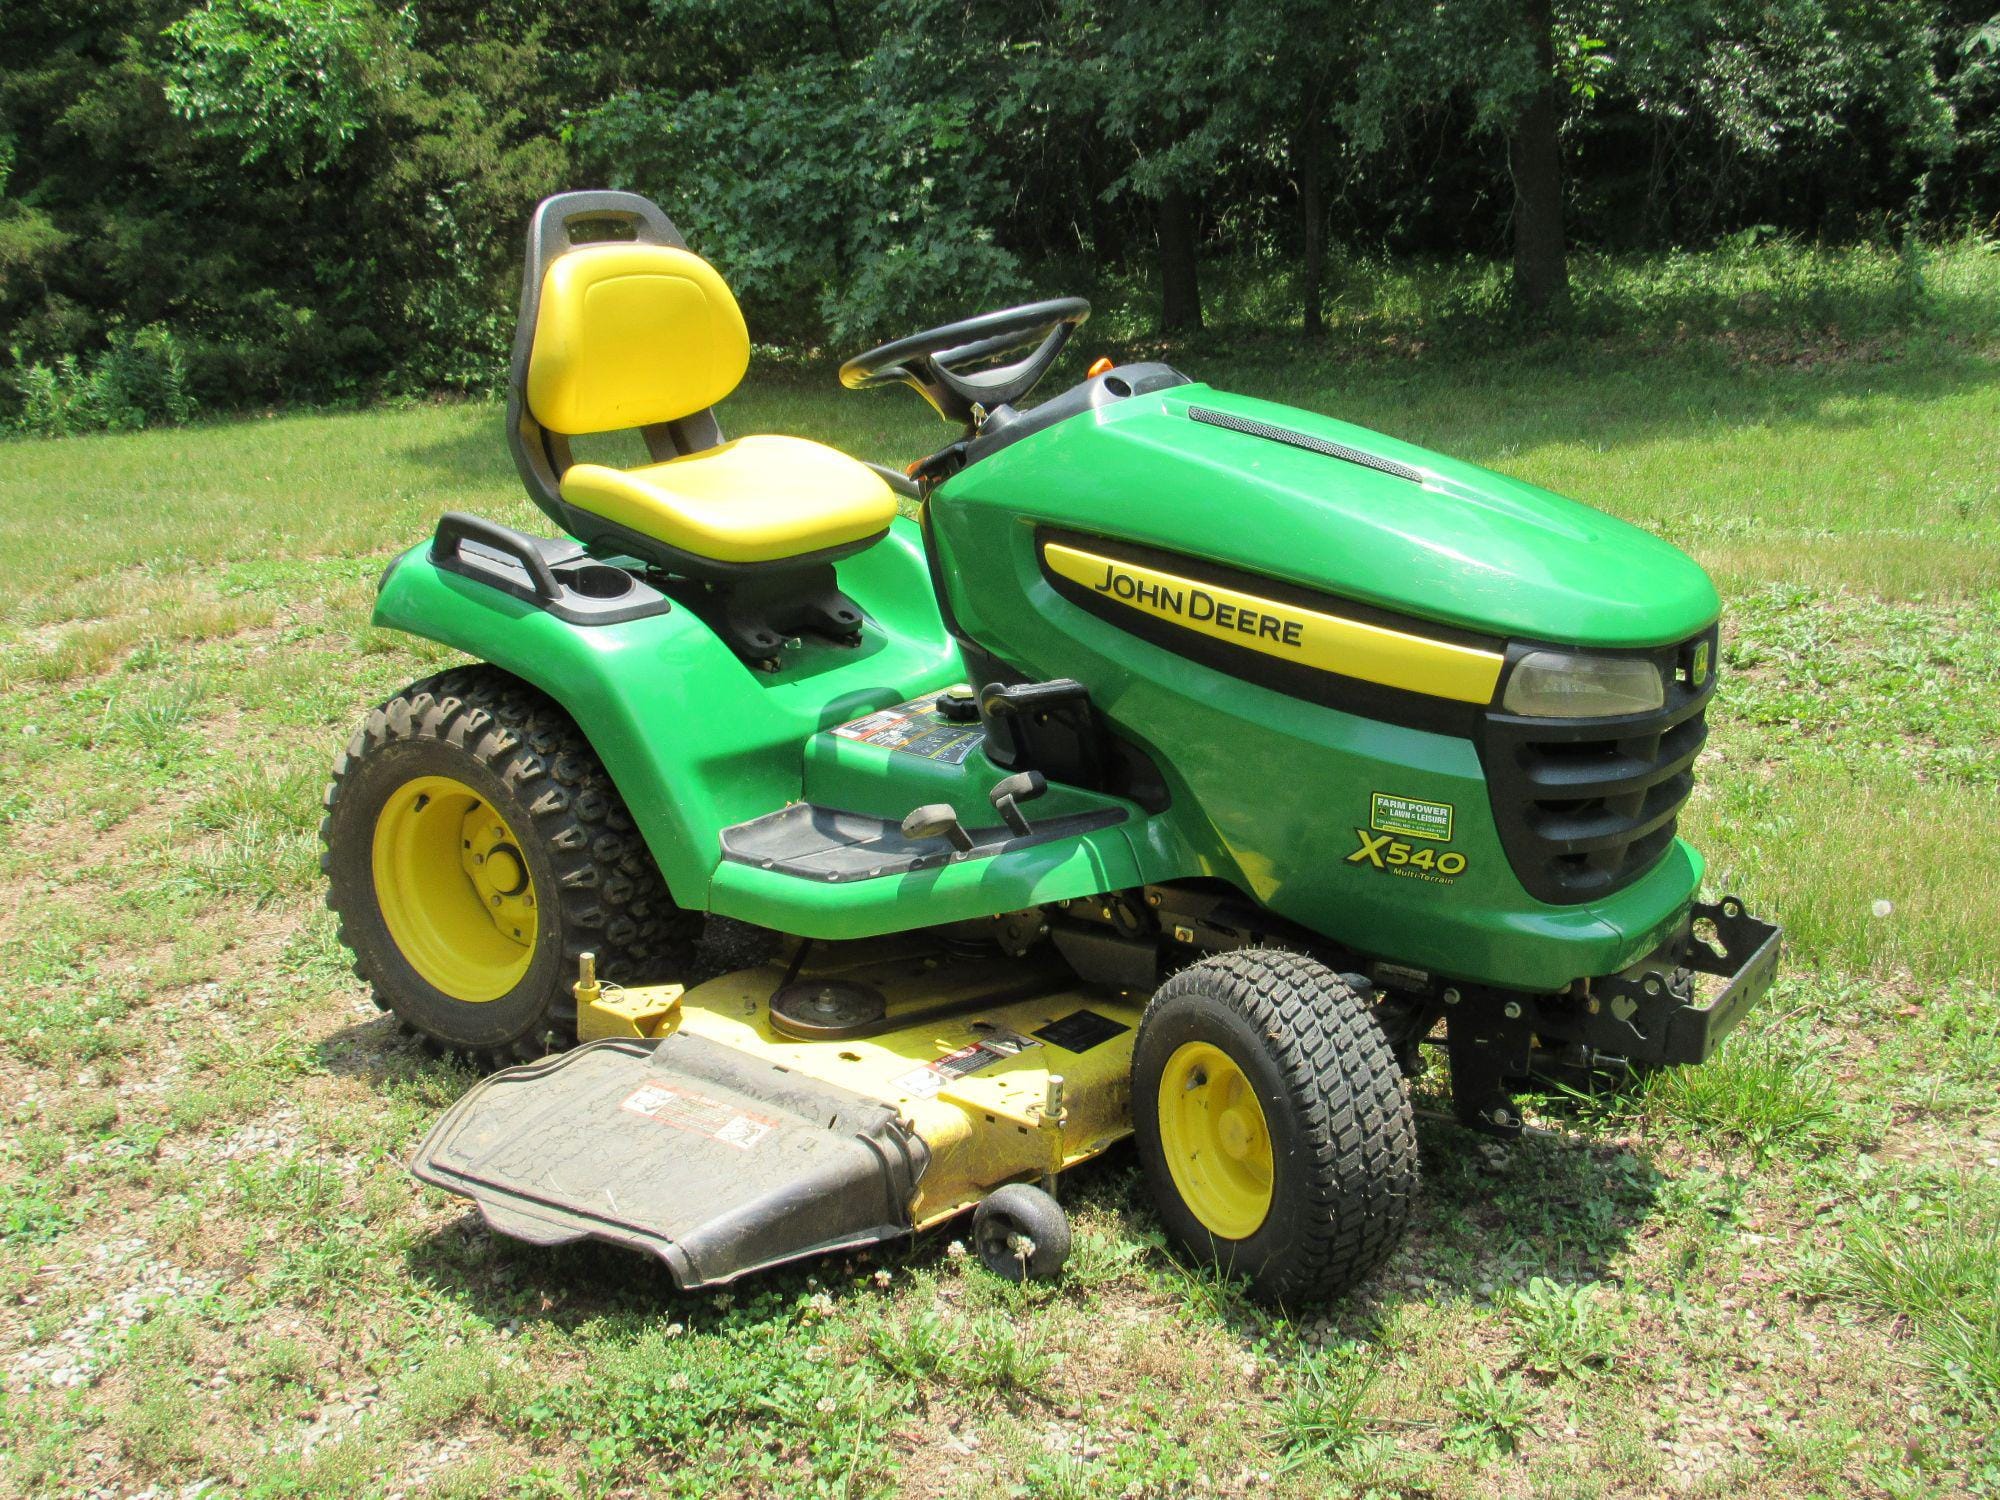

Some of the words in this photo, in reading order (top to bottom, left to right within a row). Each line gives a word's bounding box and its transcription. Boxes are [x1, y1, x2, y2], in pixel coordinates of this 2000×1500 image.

[1094, 565, 1184, 615] JOHN
[1188, 588, 1304, 647] DEERE
[1377, 797, 1406, 810] FARM
[1408, 803, 1448, 816] POWER
[1389, 808, 1411, 819] LAWN
[1416, 813, 1448, 825] LEISURE
[1346, 828, 1467, 875] X540
